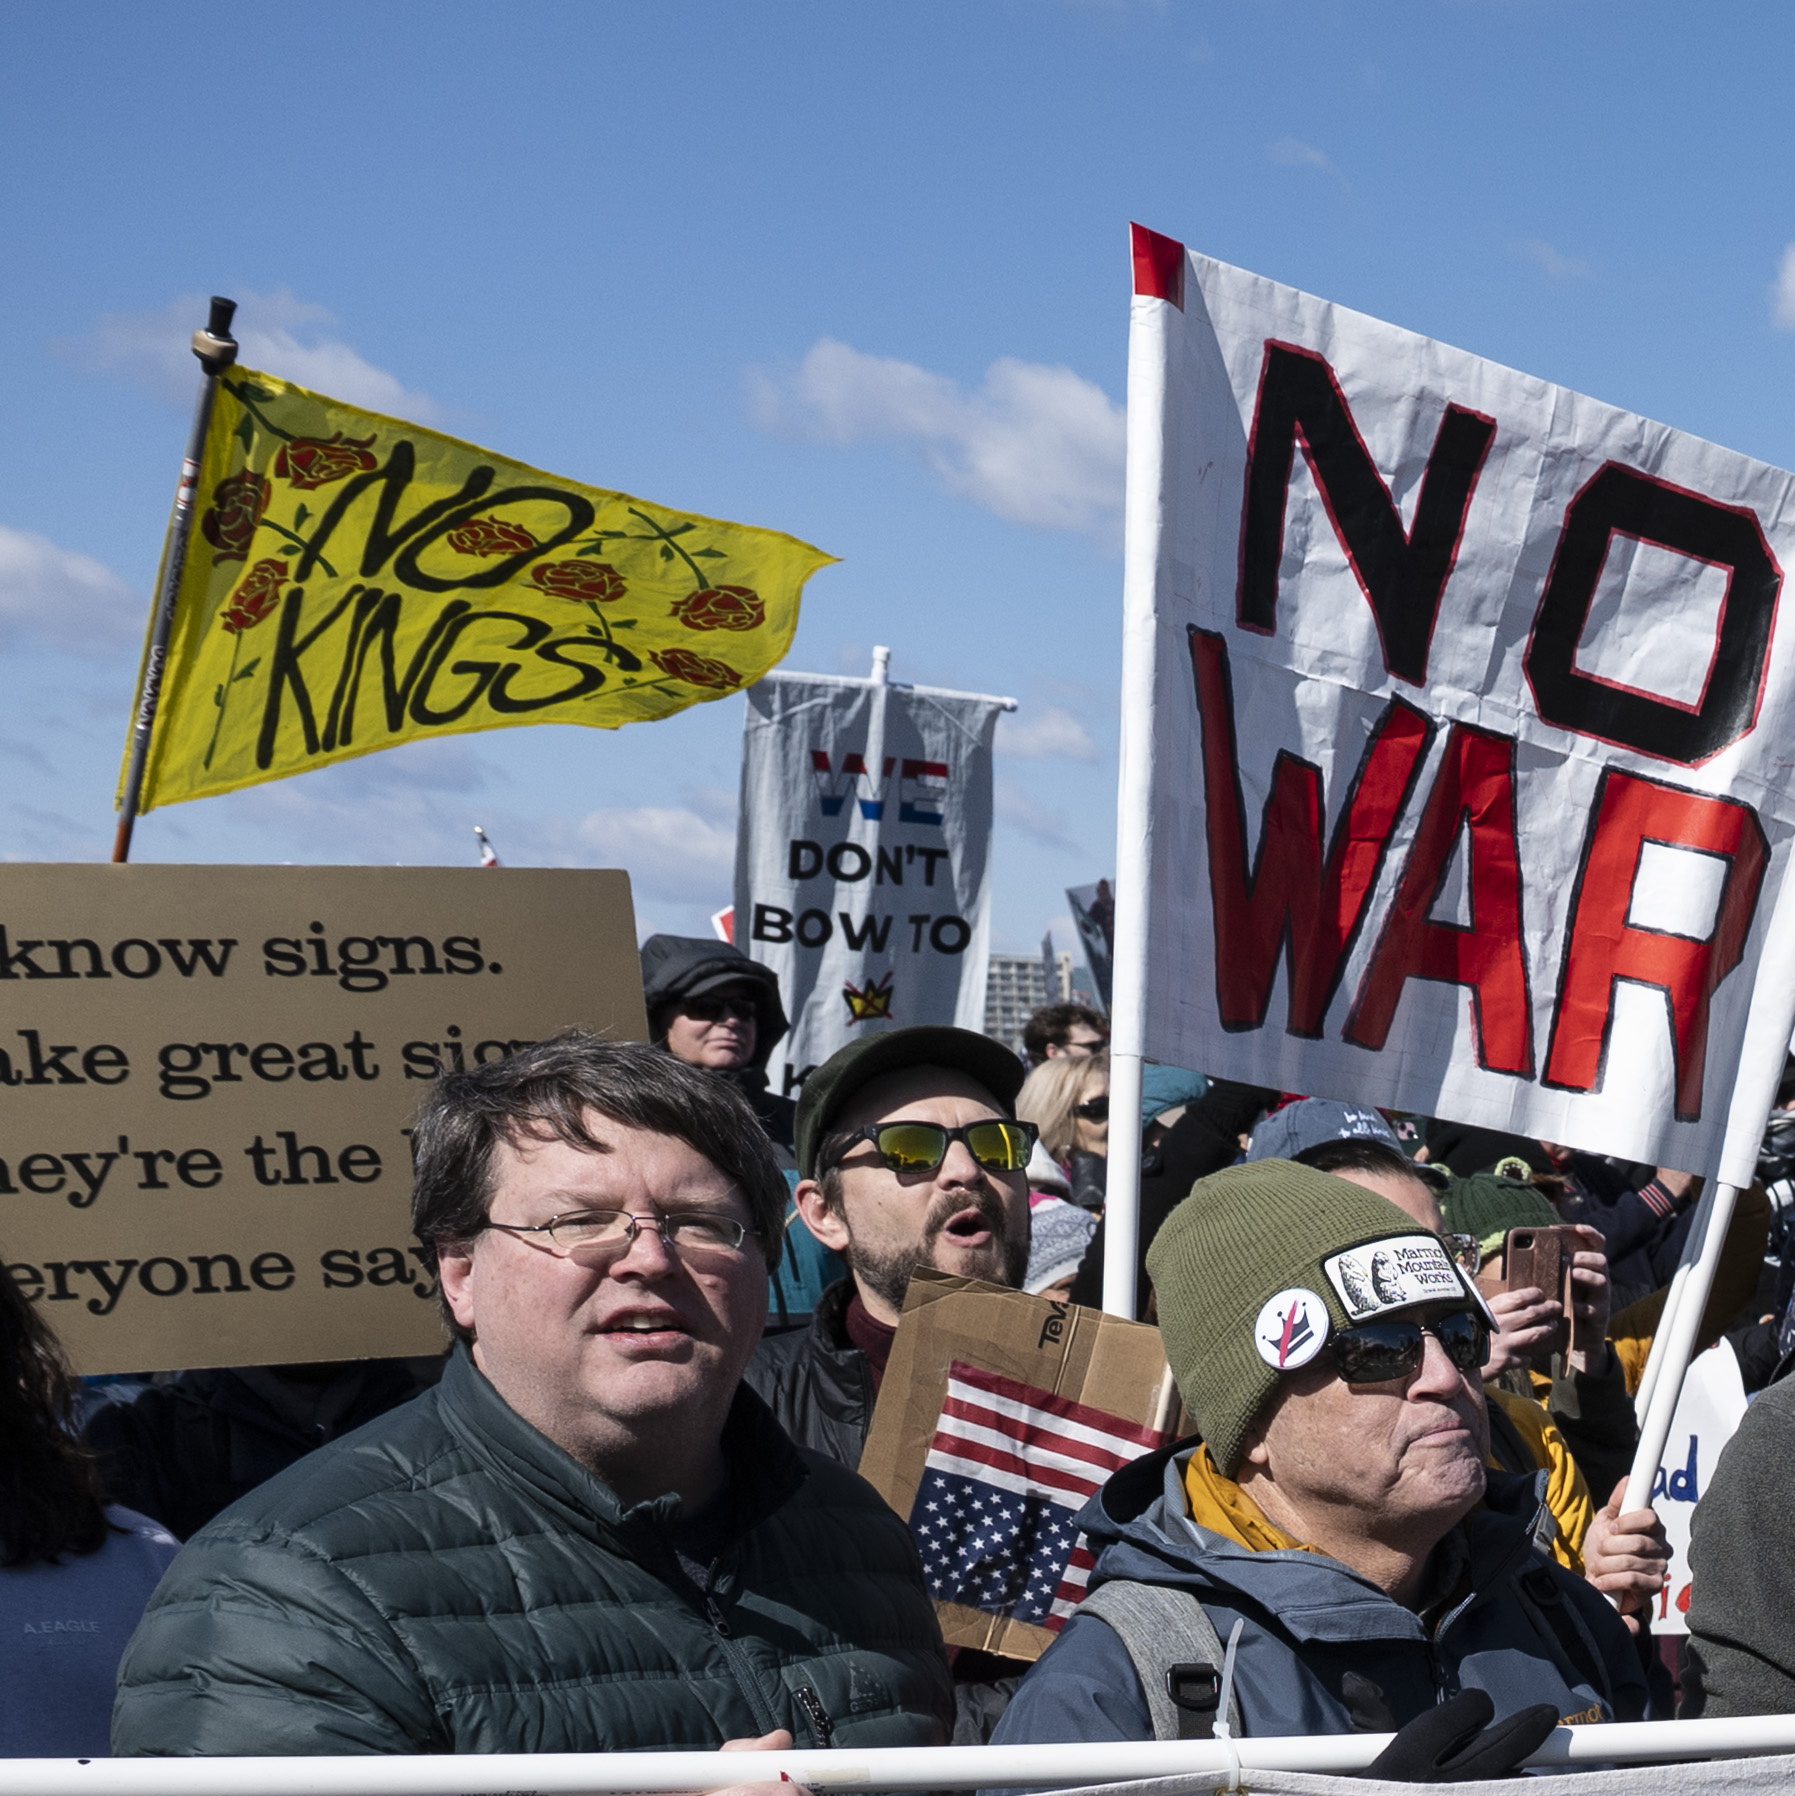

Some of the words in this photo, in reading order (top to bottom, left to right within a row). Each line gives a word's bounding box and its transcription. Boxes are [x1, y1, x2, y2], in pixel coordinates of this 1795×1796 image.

[295, 440, 596, 592] NO
[1236, 336, 1786, 770] NO
[257, 583, 642, 771] KINGS
[811, 749, 949, 827] WE
[788, 839, 949, 887] DON'T
[1187, 623, 1771, 1124] WAR
[262, 920, 503, 993] signs.
[751, 901, 893, 953] BOW
[907, 914, 973, 955] TO
[158, 1030, 380, 1100] great
[244, 1130, 382, 1186] the
[1037, 1300, 1070, 1349] Tev
